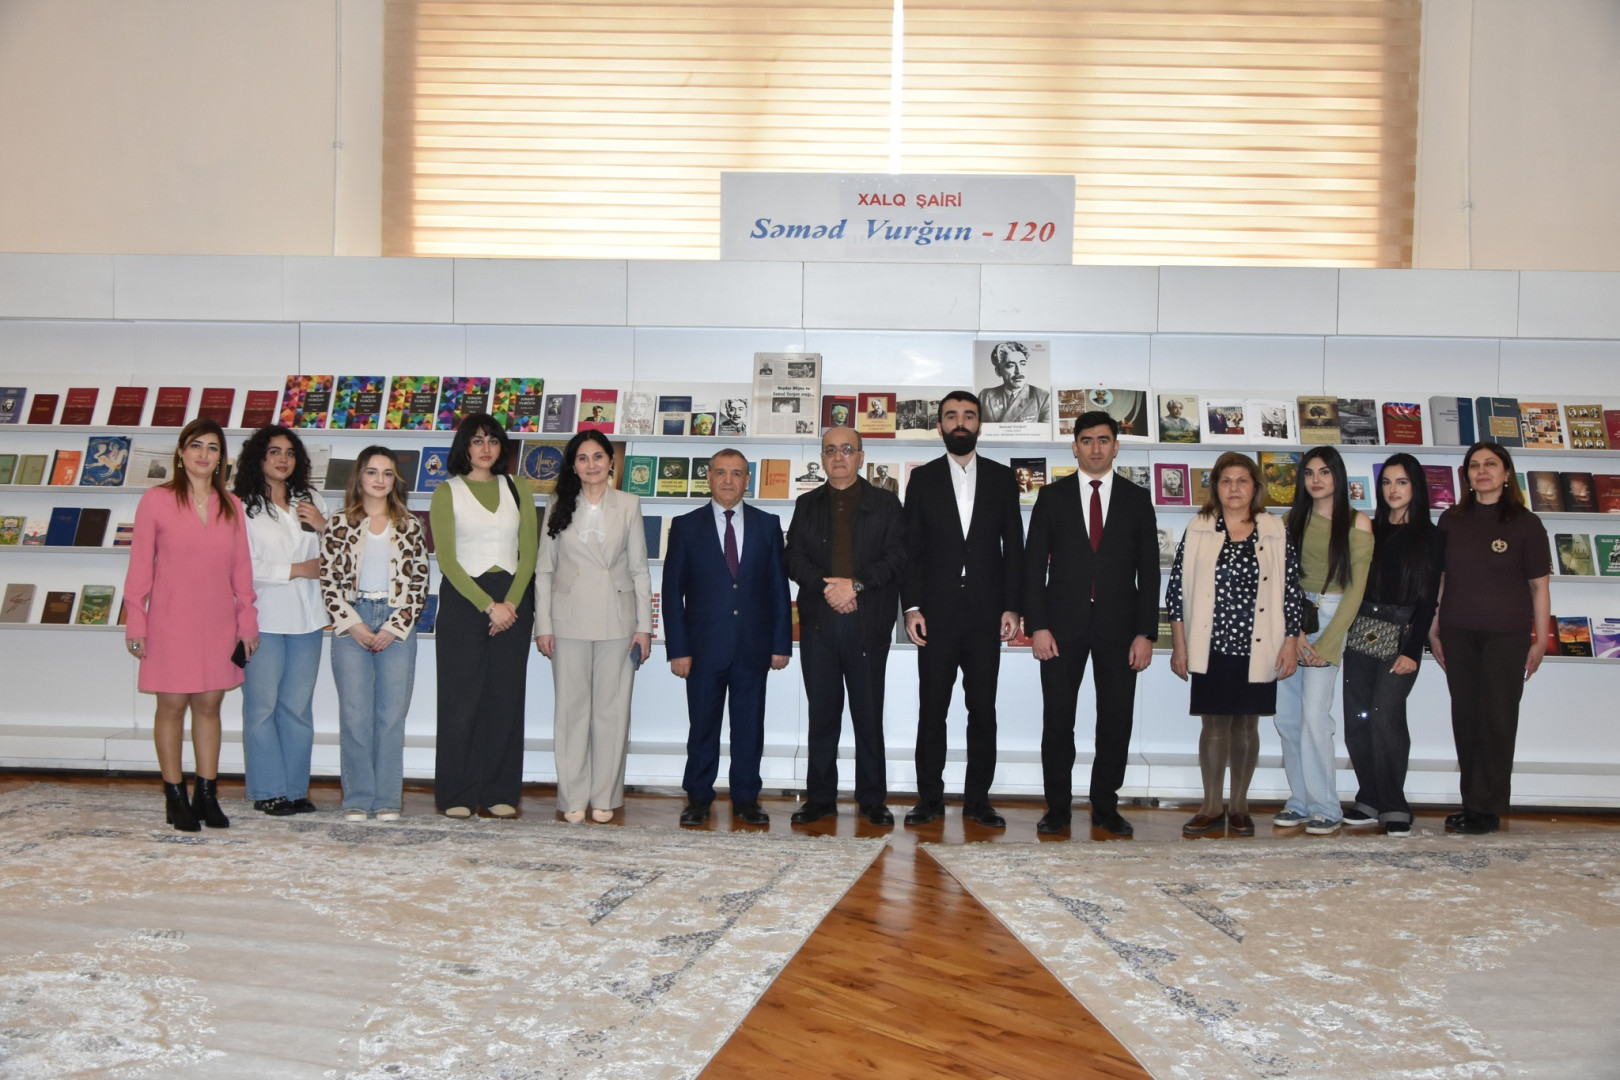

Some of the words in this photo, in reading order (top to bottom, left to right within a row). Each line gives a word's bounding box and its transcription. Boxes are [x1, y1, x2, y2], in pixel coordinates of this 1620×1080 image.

[857, 193, 906, 207] XALQ
[916, 192, 962, 209] ŞAİRİ
[750, 218, 848, 240] Səməd
[867, 218, 972, 246] Vurğun
[1002, 221, 1056, 242] 120
